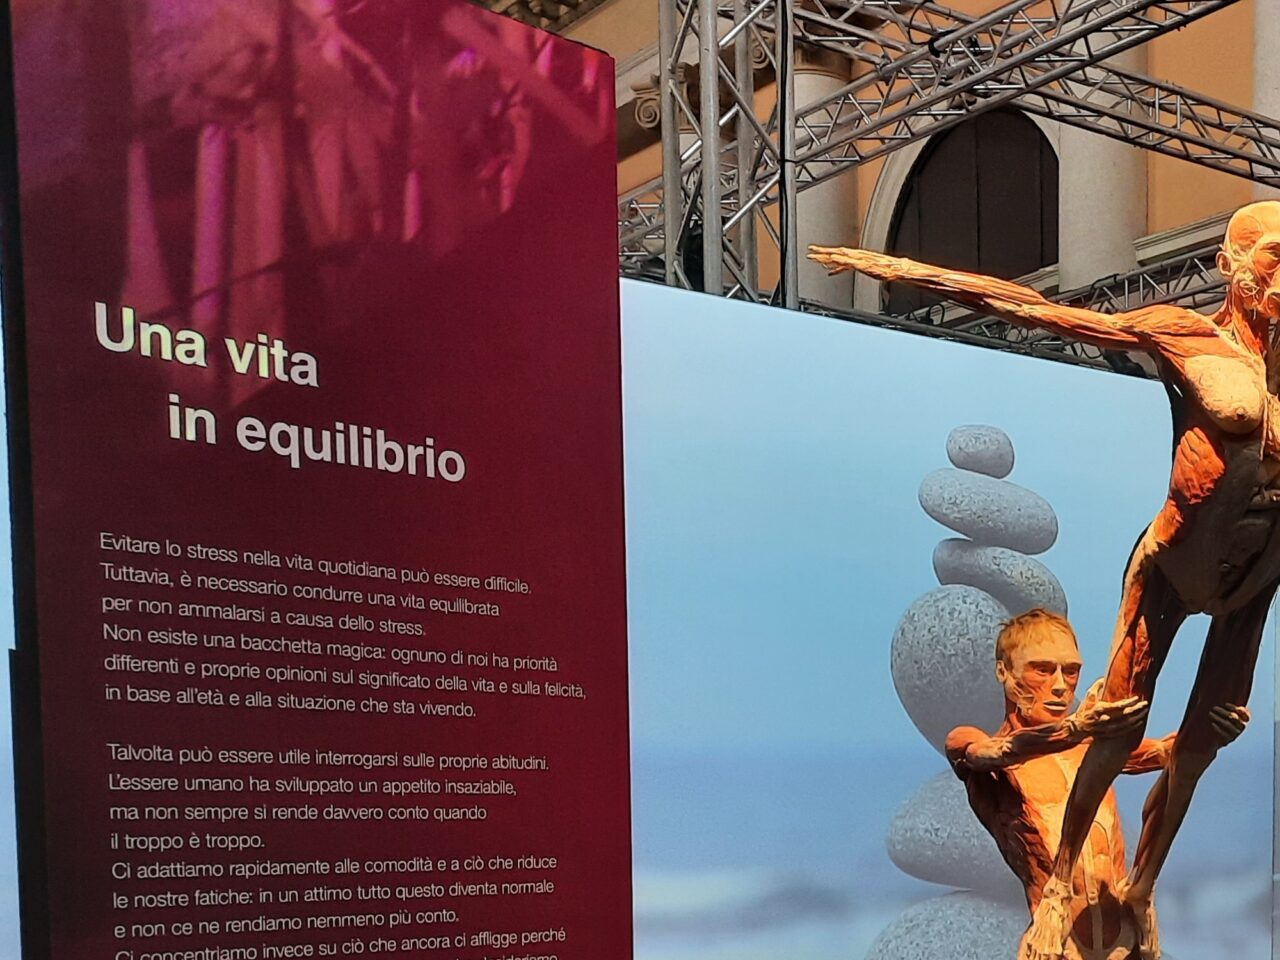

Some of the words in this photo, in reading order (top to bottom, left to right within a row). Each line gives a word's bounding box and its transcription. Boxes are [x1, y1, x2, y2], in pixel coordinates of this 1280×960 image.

[94, 301, 207, 367] Una
[224, 332, 319, 388] vita
[168, 393, 217, 445] in
[236, 415, 467, 483] equilibrio
[100, 532, 160, 555] Evitare
[166, 539, 182, 557] lo
[187, 544, 238, 563] stress
[243, 550, 281, 567] nella
[285, 553, 313, 571] vita
[318, 560, 397, 580] quotidiana
[401, 568, 429, 583] può
[434, 573, 480, 588] essere
[484, 576, 531, 594] difficile.
[99, 562, 174, 587] Tuttavia,
[180, 570, 192, 587] è
[197, 576, 288, 596] necessario
[293, 585, 363, 603] condurre
[368, 593, 396, 606] una
[400, 593, 425, 609] vita
[429, 598, 499, 616] equilibrata
[102, 597, 133, 613] per
[138, 600, 172, 614] non
[178, 603, 265, 622] ammalarsi
[270, 611, 281, 623] a
[286, 613, 334, 628] causa
[339, 614, 374, 631] dello
[379, 619, 426, 635] stress.
[103, 623, 142, 642] Non
[147, 628, 198, 646] esiste
[203, 635, 236, 648] una
[241, 633, 322, 654] bacchetta
[327, 642, 386, 661] magica:
[391, 648, 446, 664] ognuno
[451, 650, 463, 664] di
[468, 652, 488, 666] noi
[492, 653, 509, 668] ha
[513, 656, 557, 671] priorità
[104, 654, 179, 674] differenti
[184, 662, 195, 675] e
[201, 662, 260, 680] proprie
[266, 665, 327, 683] opinioni
[332, 669, 353, 684] sul
[359, 670, 430, 689] significato
[435, 675, 467, 691] della
[471, 677, 495, 692] vita
[499, 682, 508, 693] e
[512, 681, 540, 695] sulla
[545, 682, 586, 699] felicità,
[105, 683, 121, 700] in
[127, 684, 171, 703] base
[229, 693, 240, 706] e
[245, 691, 272, 707] alla
[277, 693, 356, 711] situazione
[360, 697, 388, 713] che
[393, 699, 415, 714] sta
[419, 700, 476, 717] vivendo.
[106, 743, 174, 761] Talvolta
[179, 746, 213, 765] può
[218, 750, 273, 764] essere
[279, 749, 310, 764] utile
[315, 749, 398, 769] interrogarsi
[403, 753, 435, 767] sulle
[439, 754, 488, 771] proprie
[492, 754, 549, 770] abitudini.
[185, 778, 244, 791] umano
[249, 776, 271, 792] ha
[275, 776, 353, 795] sviluppato
[359, 781, 378, 792] un
[382, 779, 441, 796] appetito
[445, 779, 516, 796] insaziabile,
[110, 807, 140, 820] ma
[145, 807, 178, 820] non
[184, 807, 248, 823] sempre
[254, 804, 267, 819] si
[272, 804, 318, 819] rende
[323, 804, 383, 820] davvero
[388, 806, 429, 819] conto
[433, 805, 487, 822] quando
[111, 833, 118, 849] il
[124, 834, 184, 852] troppo
[189, 832, 200, 848] è
[205, 833, 265, 851] troppo.
[112, 862, 131, 879] Ci
[137, 861, 224, 878] adattiamo
[229, 860, 330, 879] rapidamente
[335, 858, 360, 874] alle
[364, 856, 433, 873] comodità
[437, 860, 446, 871] e
[451, 860, 459, 871] a
[464, 856, 484, 870] ciò
[488, 856, 513, 870] che
[517, 855, 557, 869] riduce
[113, 892, 129, 908] le
[134, 891, 189, 907] nostre
[194, 889, 253, 906] fatiche:
[259, 888, 273, 903] in
[279, 890, 298, 902] un
[304, 885, 352, 901] attimo
[357, 885, 391, 900] tutto
[395, 883, 445, 901] questo
[449, 881, 498, 896] diventa
[502, 879, 554, 894] normale
[114, 925, 126, 938] e
[132, 924, 165, 937] non
[171, 922, 193, 935] ce
[199, 921, 220, 934] ne
[226, 915, 302, 932] rendiamo
[307, 914, 385, 928] nemmeno
[389, 909, 411, 928] più
[416, 909, 459, 924] conto.
[263, 944, 314, 959] invece
[318, 943, 337, 955] su
[342, 938, 364, 954] ciò
[369, 937, 397, 952] che
[401, 937, 450, 950] ancora
[454, 933, 466, 947] ci
[470, 931, 518, 948] affligge
[521, 927, 566, 946] perché
